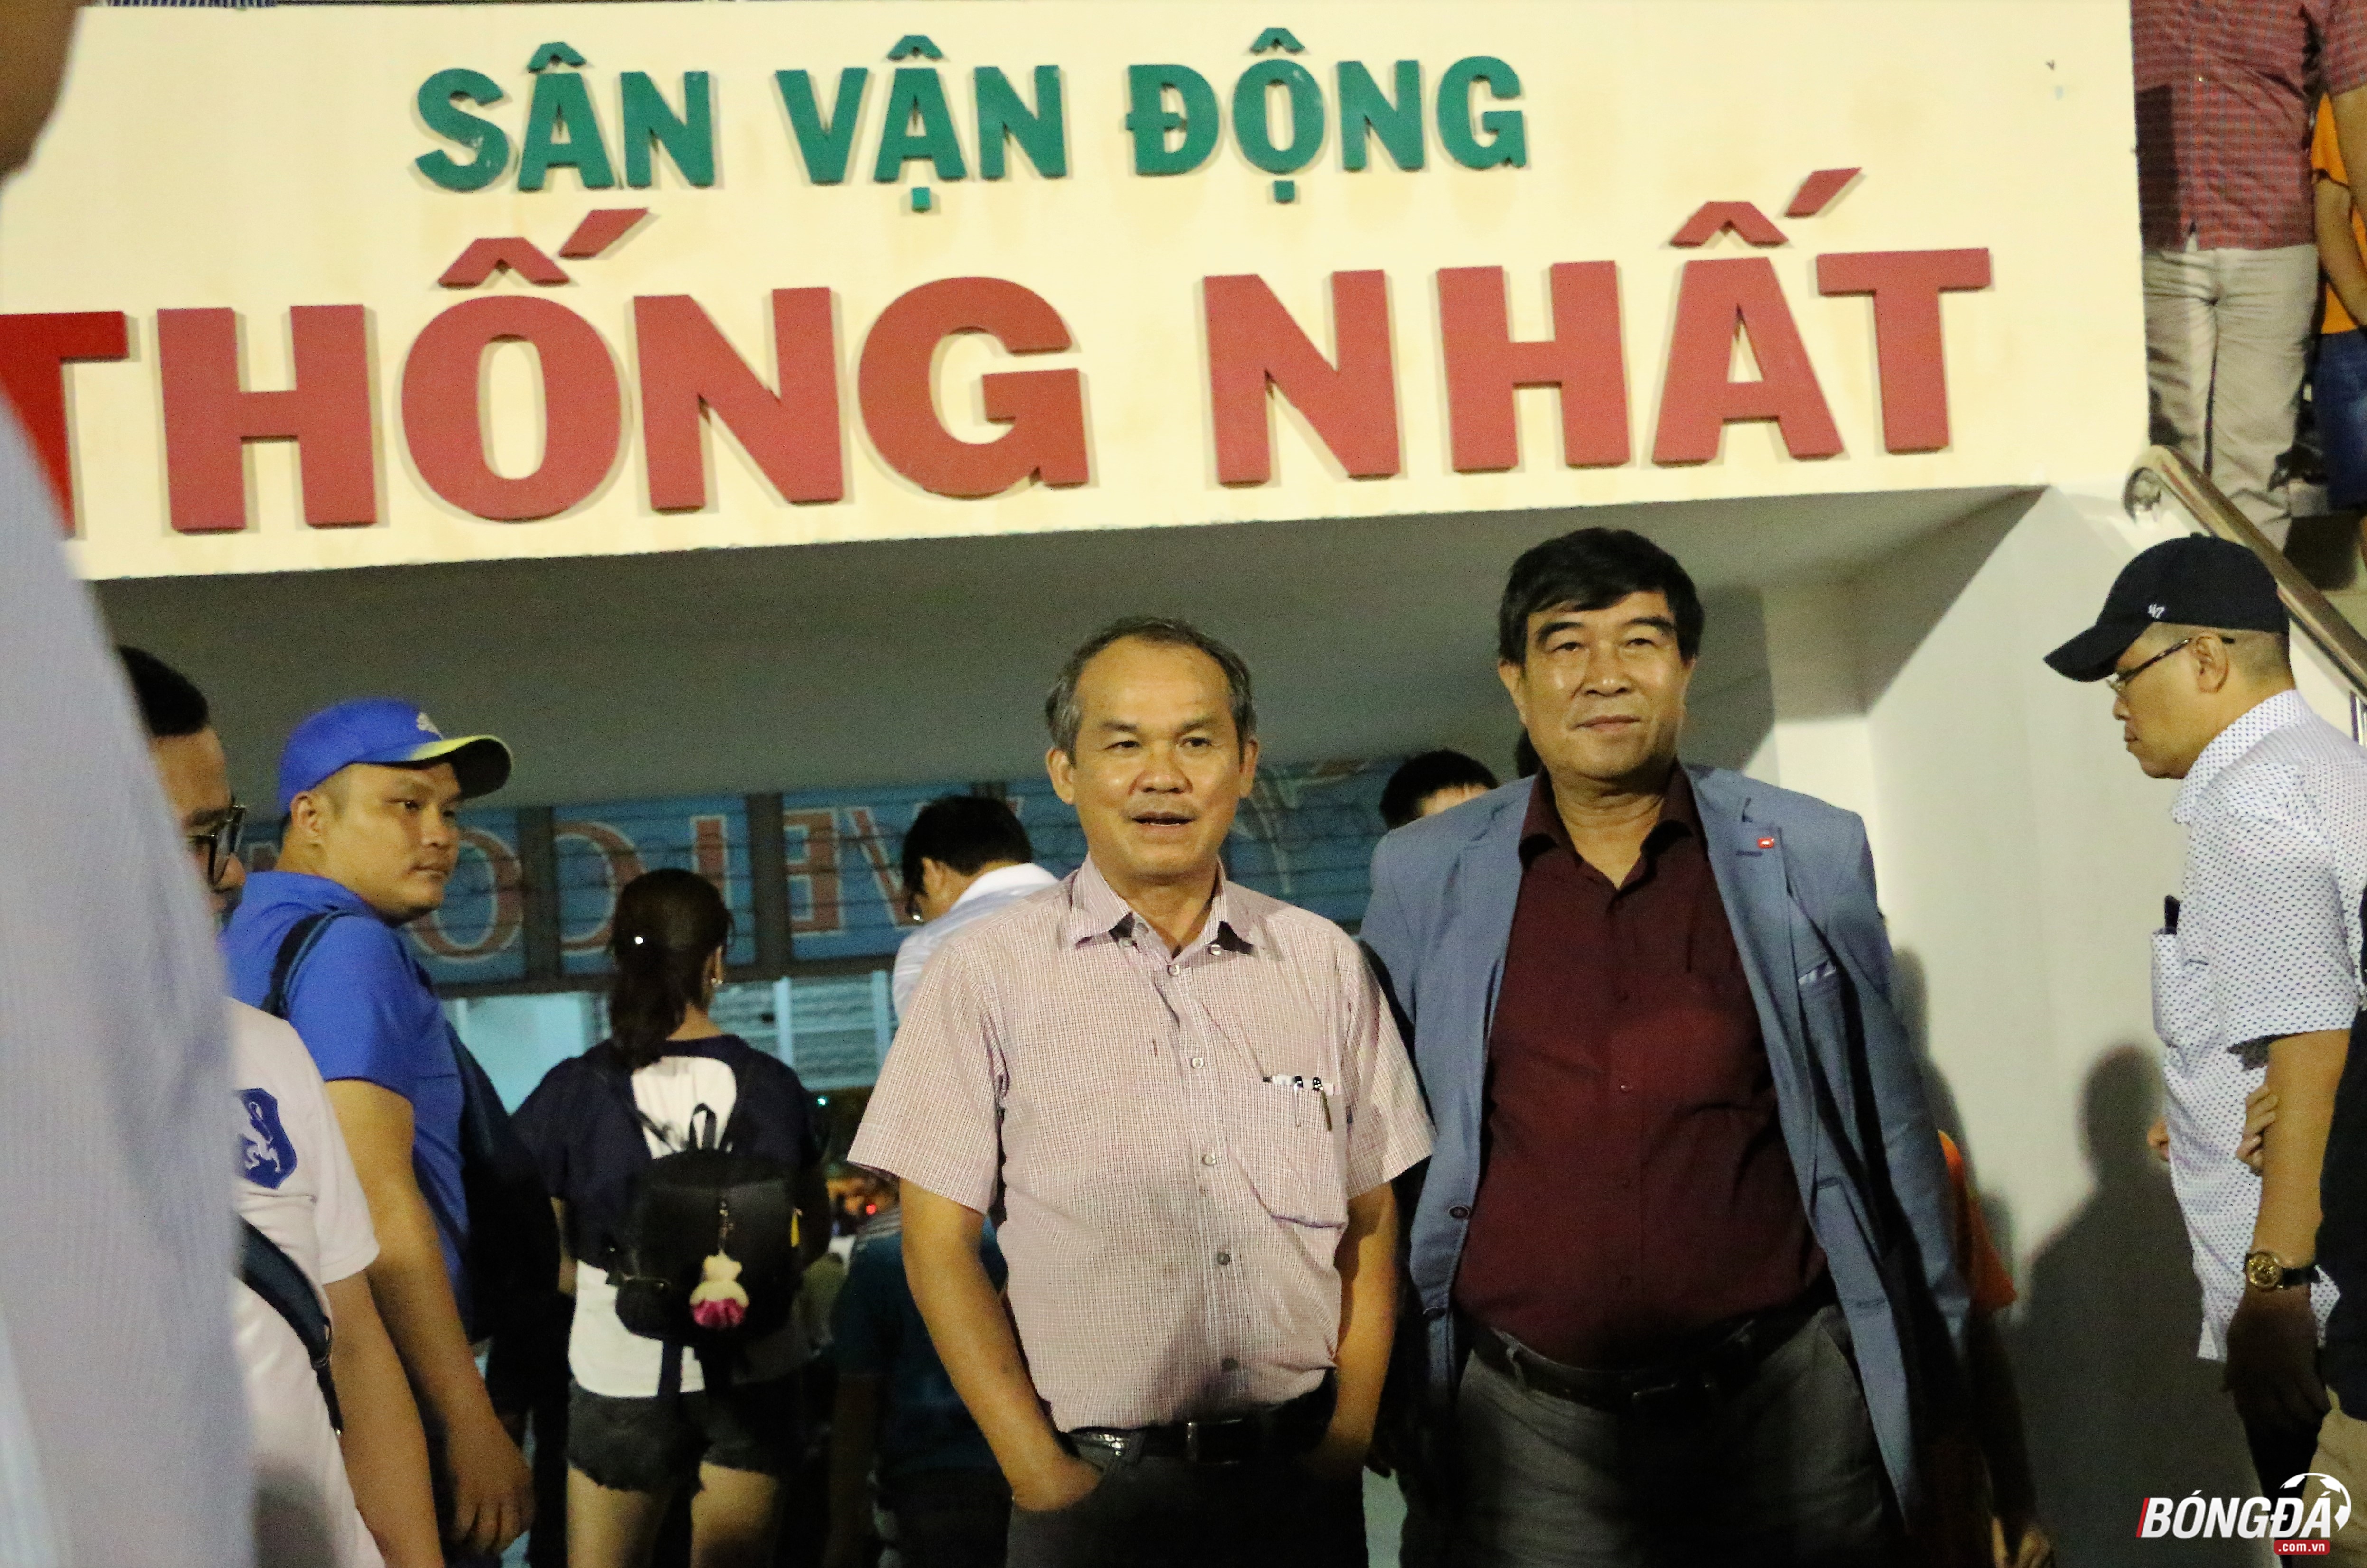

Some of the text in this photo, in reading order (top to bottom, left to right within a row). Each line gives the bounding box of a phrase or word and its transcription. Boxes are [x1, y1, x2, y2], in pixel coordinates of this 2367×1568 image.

[414, 28, 1527, 212] SÂN VẬN ĐỘNG
[0, 167, 1992, 535] THỐNG NHẤT
